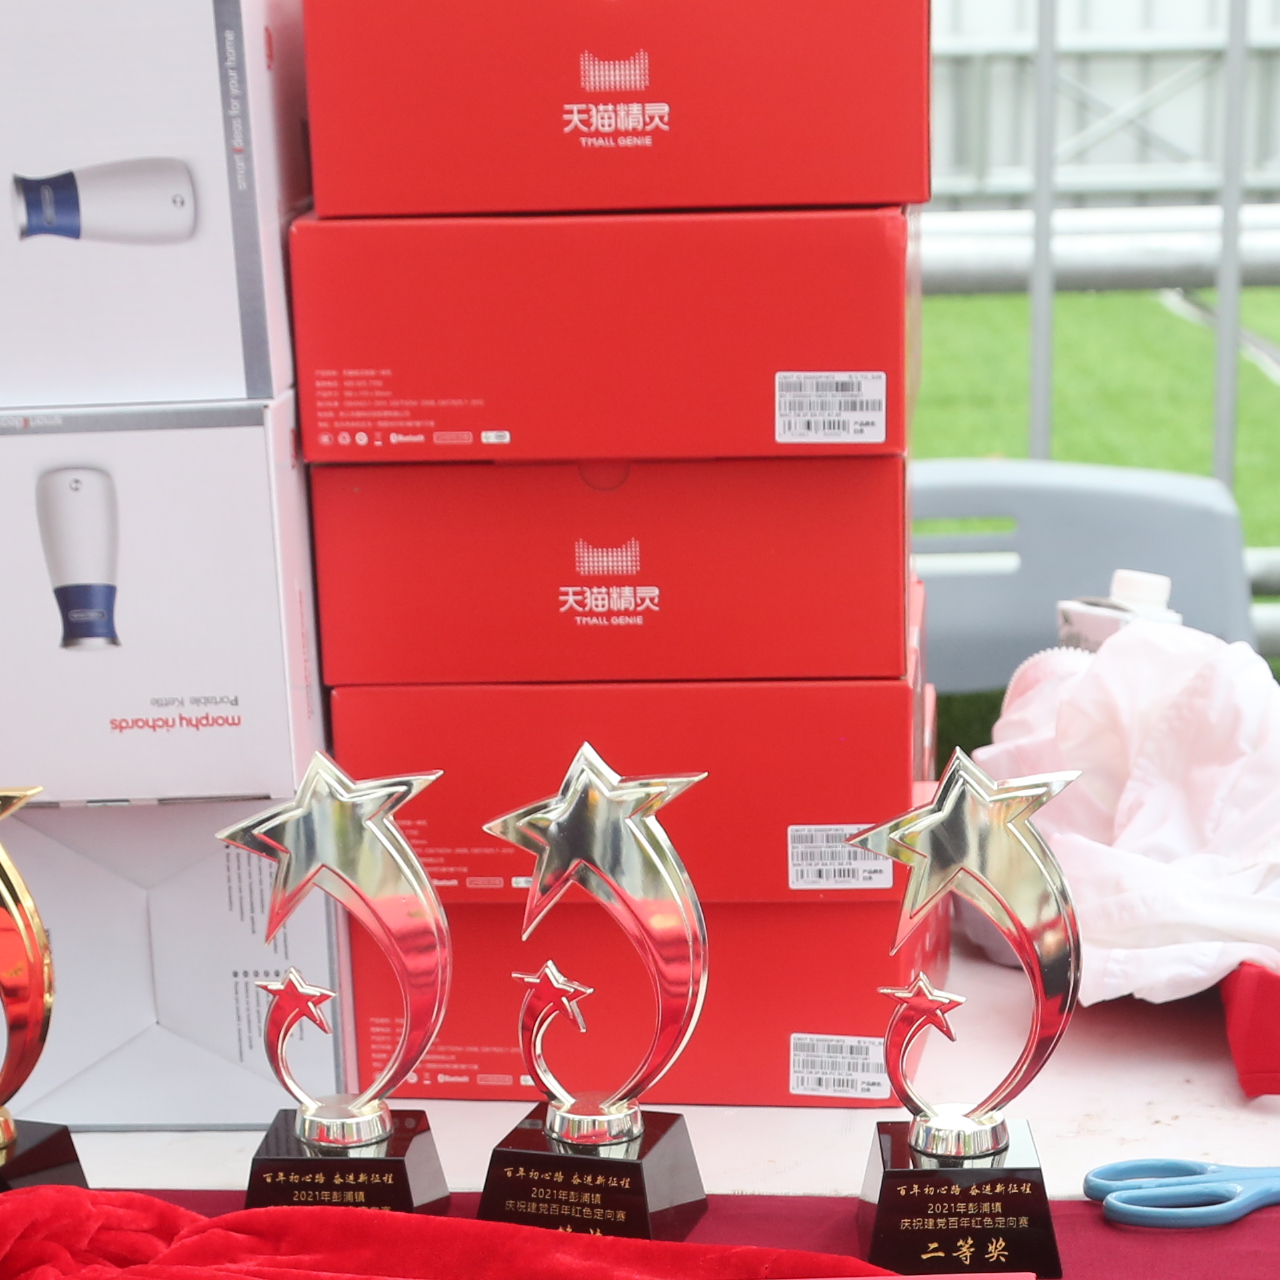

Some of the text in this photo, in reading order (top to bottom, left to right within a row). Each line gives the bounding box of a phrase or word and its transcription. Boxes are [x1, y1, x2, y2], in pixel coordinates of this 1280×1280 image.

[223, 29, 236, 67] home
[227, 68, 242, 97] your
[227, 98, 240, 116] for
[562, 102, 670, 133] 天猫精灵
[580, 135, 653, 147] TMALL GENIE
[234, 155, 247, 190] smart
[558, 586, 660, 612] 天猫精灵
[575, 615, 644, 625] TMALL GENIE
[149, 696, 238, 708] Portable Kettle
[109, 713, 242, 733] morphy richards
[263, 1172, 394, 1184] 百年初心路 奋进新征程
[504, 1167, 631, 1189] 百年初心路 奋进新征程
[293, 1191, 365, 1202] 2021年彭浦镇
[531, 1188, 602, 1205] 2021年彭浦镇
[897, 1183, 1032, 1196] 百年初心路 奋进新征程
[505, 1200, 626, 1221] 庆祝建党百年红色定向赛
[928, 1202, 1002, 1214] 2021年彭浦镇
[900, 1216, 1029, 1230] 庆祝建党百年红色定向赛
[921, 1236, 1009, 1265] 二等奖
